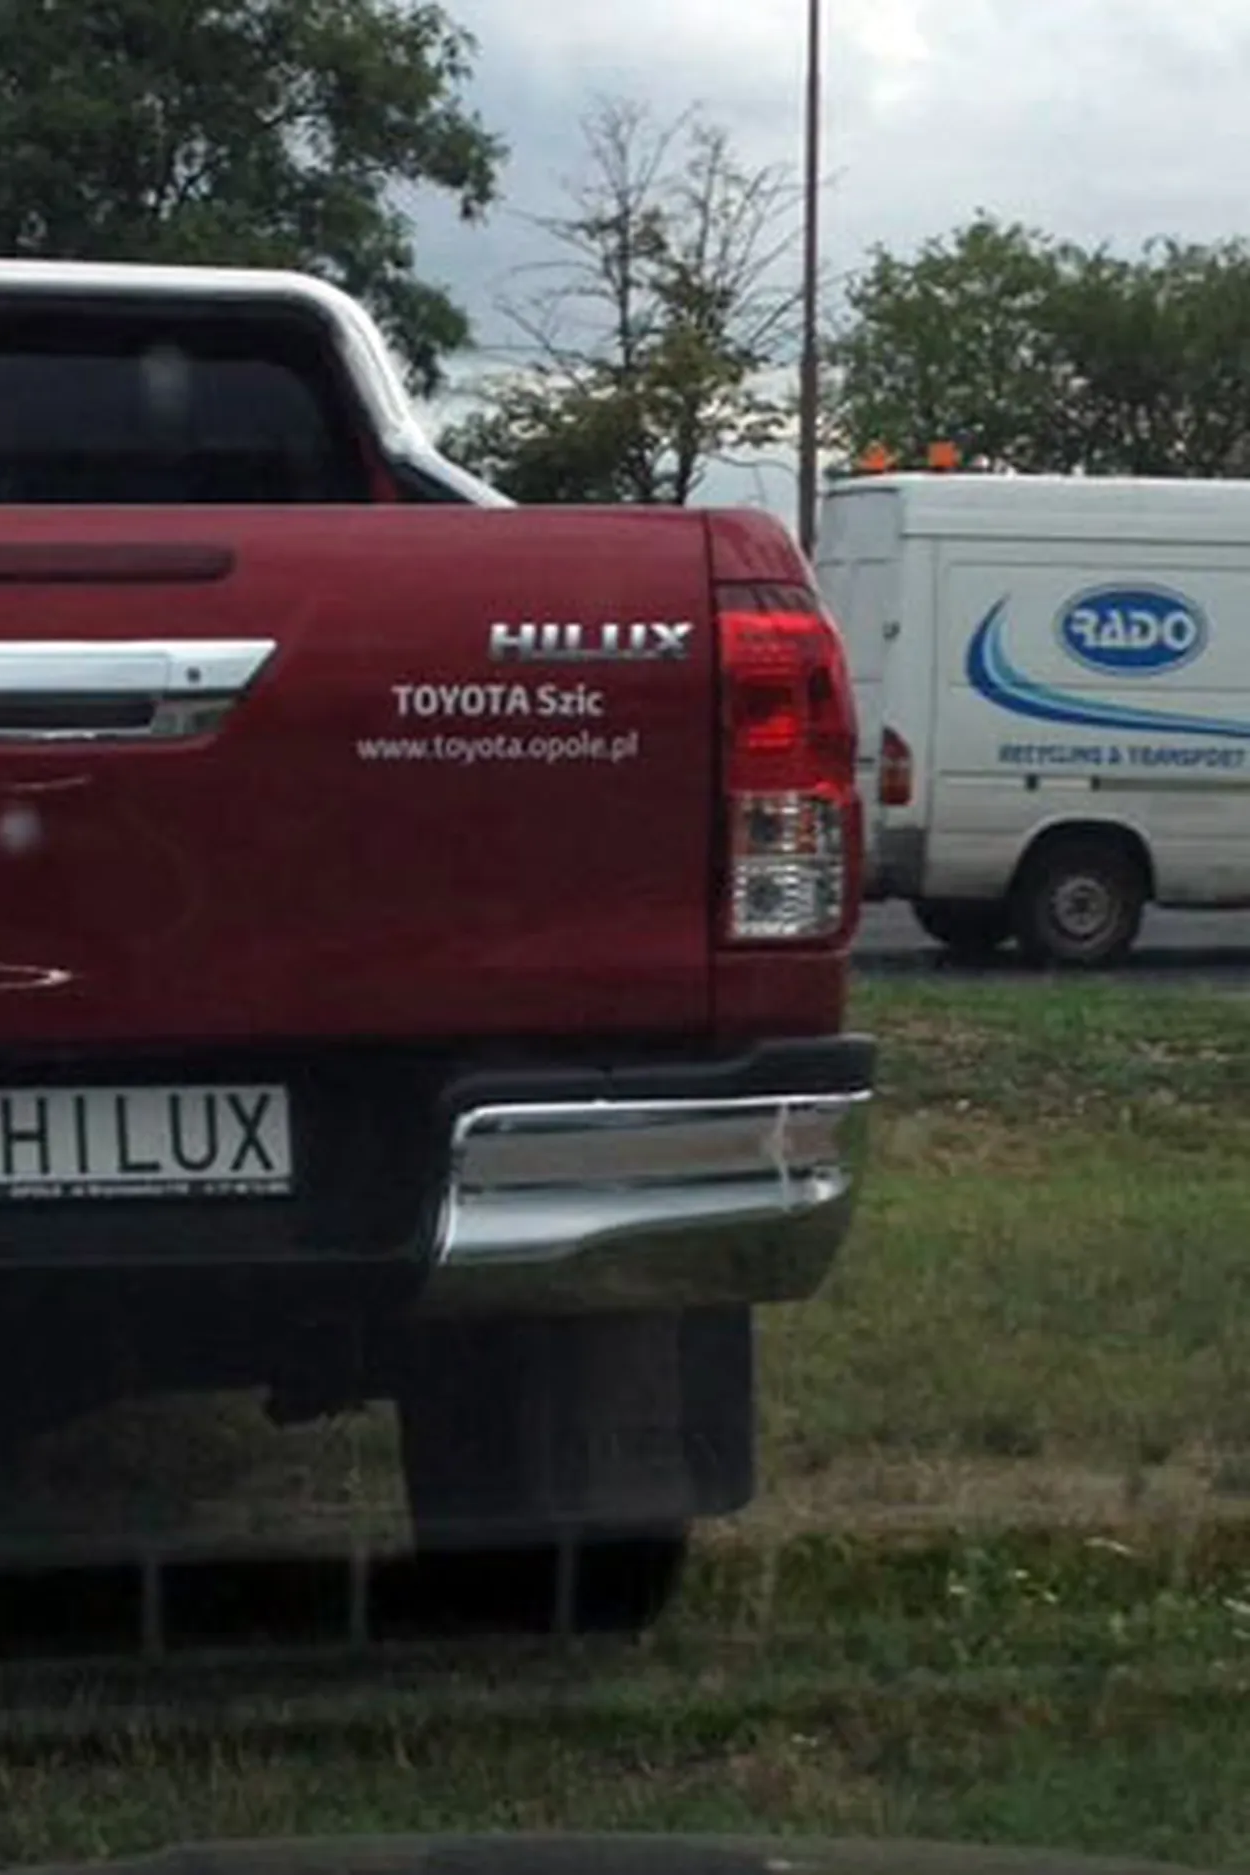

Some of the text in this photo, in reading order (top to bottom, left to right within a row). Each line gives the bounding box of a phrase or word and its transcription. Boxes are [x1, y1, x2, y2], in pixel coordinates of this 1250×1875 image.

[488, 622, 693, 661] HILUX
[1069, 607, 1197, 650] RADO
[391, 684, 604, 716] TOYOTA Szic
[356, 731, 640, 764] www.toyota.opole.pl
[1128, 746, 1246, 767] TRANSPORT
[0, 1092, 274, 1176] HILUX
